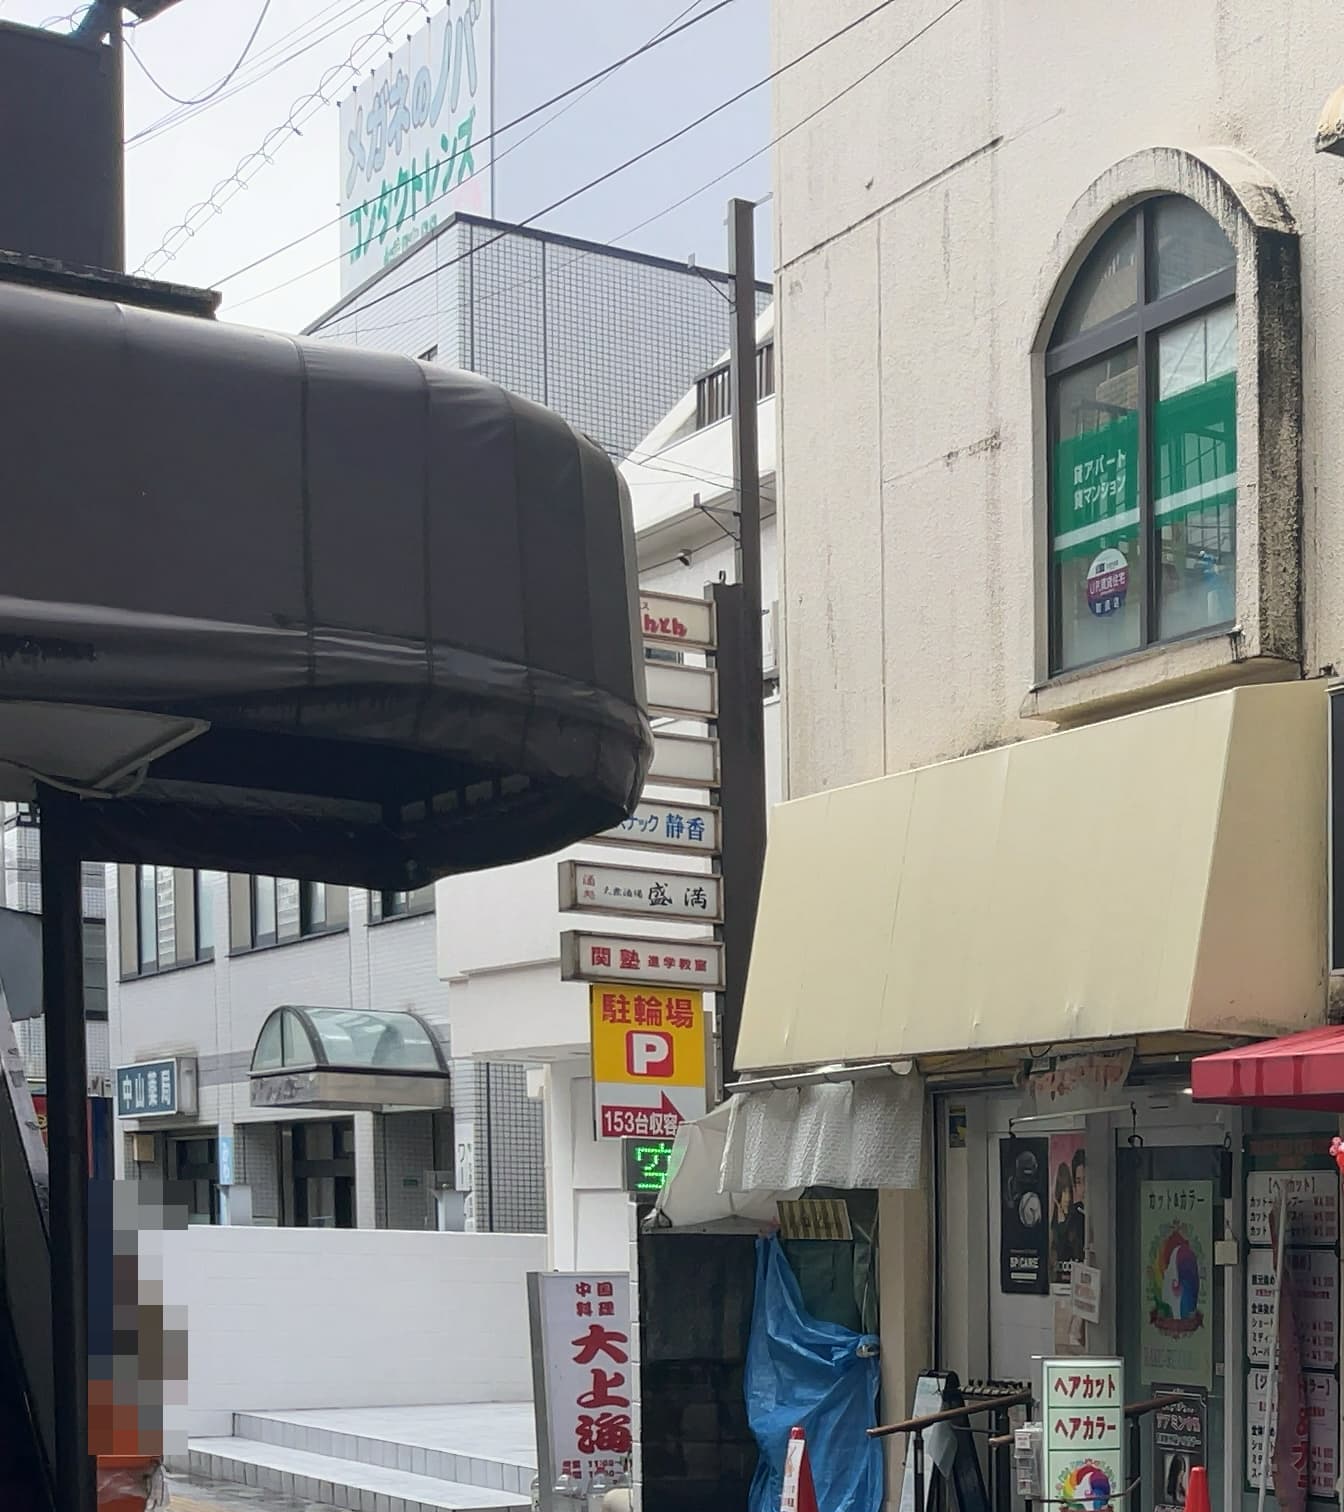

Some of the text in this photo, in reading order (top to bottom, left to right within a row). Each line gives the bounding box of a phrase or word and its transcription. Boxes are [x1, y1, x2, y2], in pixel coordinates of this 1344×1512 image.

[350, 104, 475, 264] コンタクトレンズ
[1074, 449, 1126, 485] 貸アパート
[1074, 475, 1125, 510] 貸マンション
[665, 812, 704, 841] 静香
[591, 946, 707, 972] 関塾 進学教室
[602, 993, 694, 1028] 駐輪場
[632, 1033, 669, 1074] P
[604, 1110, 678, 1136] 153台収容
[576, 1281, 613, 1297] 中国
[576, 1300, 614, 1317] 料理
[571, 1324, 633, 1454] 大上海
[1054, 1374, 1115, 1399] ヘアカット
[1055, 1415, 1117, 1440] ヘアカラー
